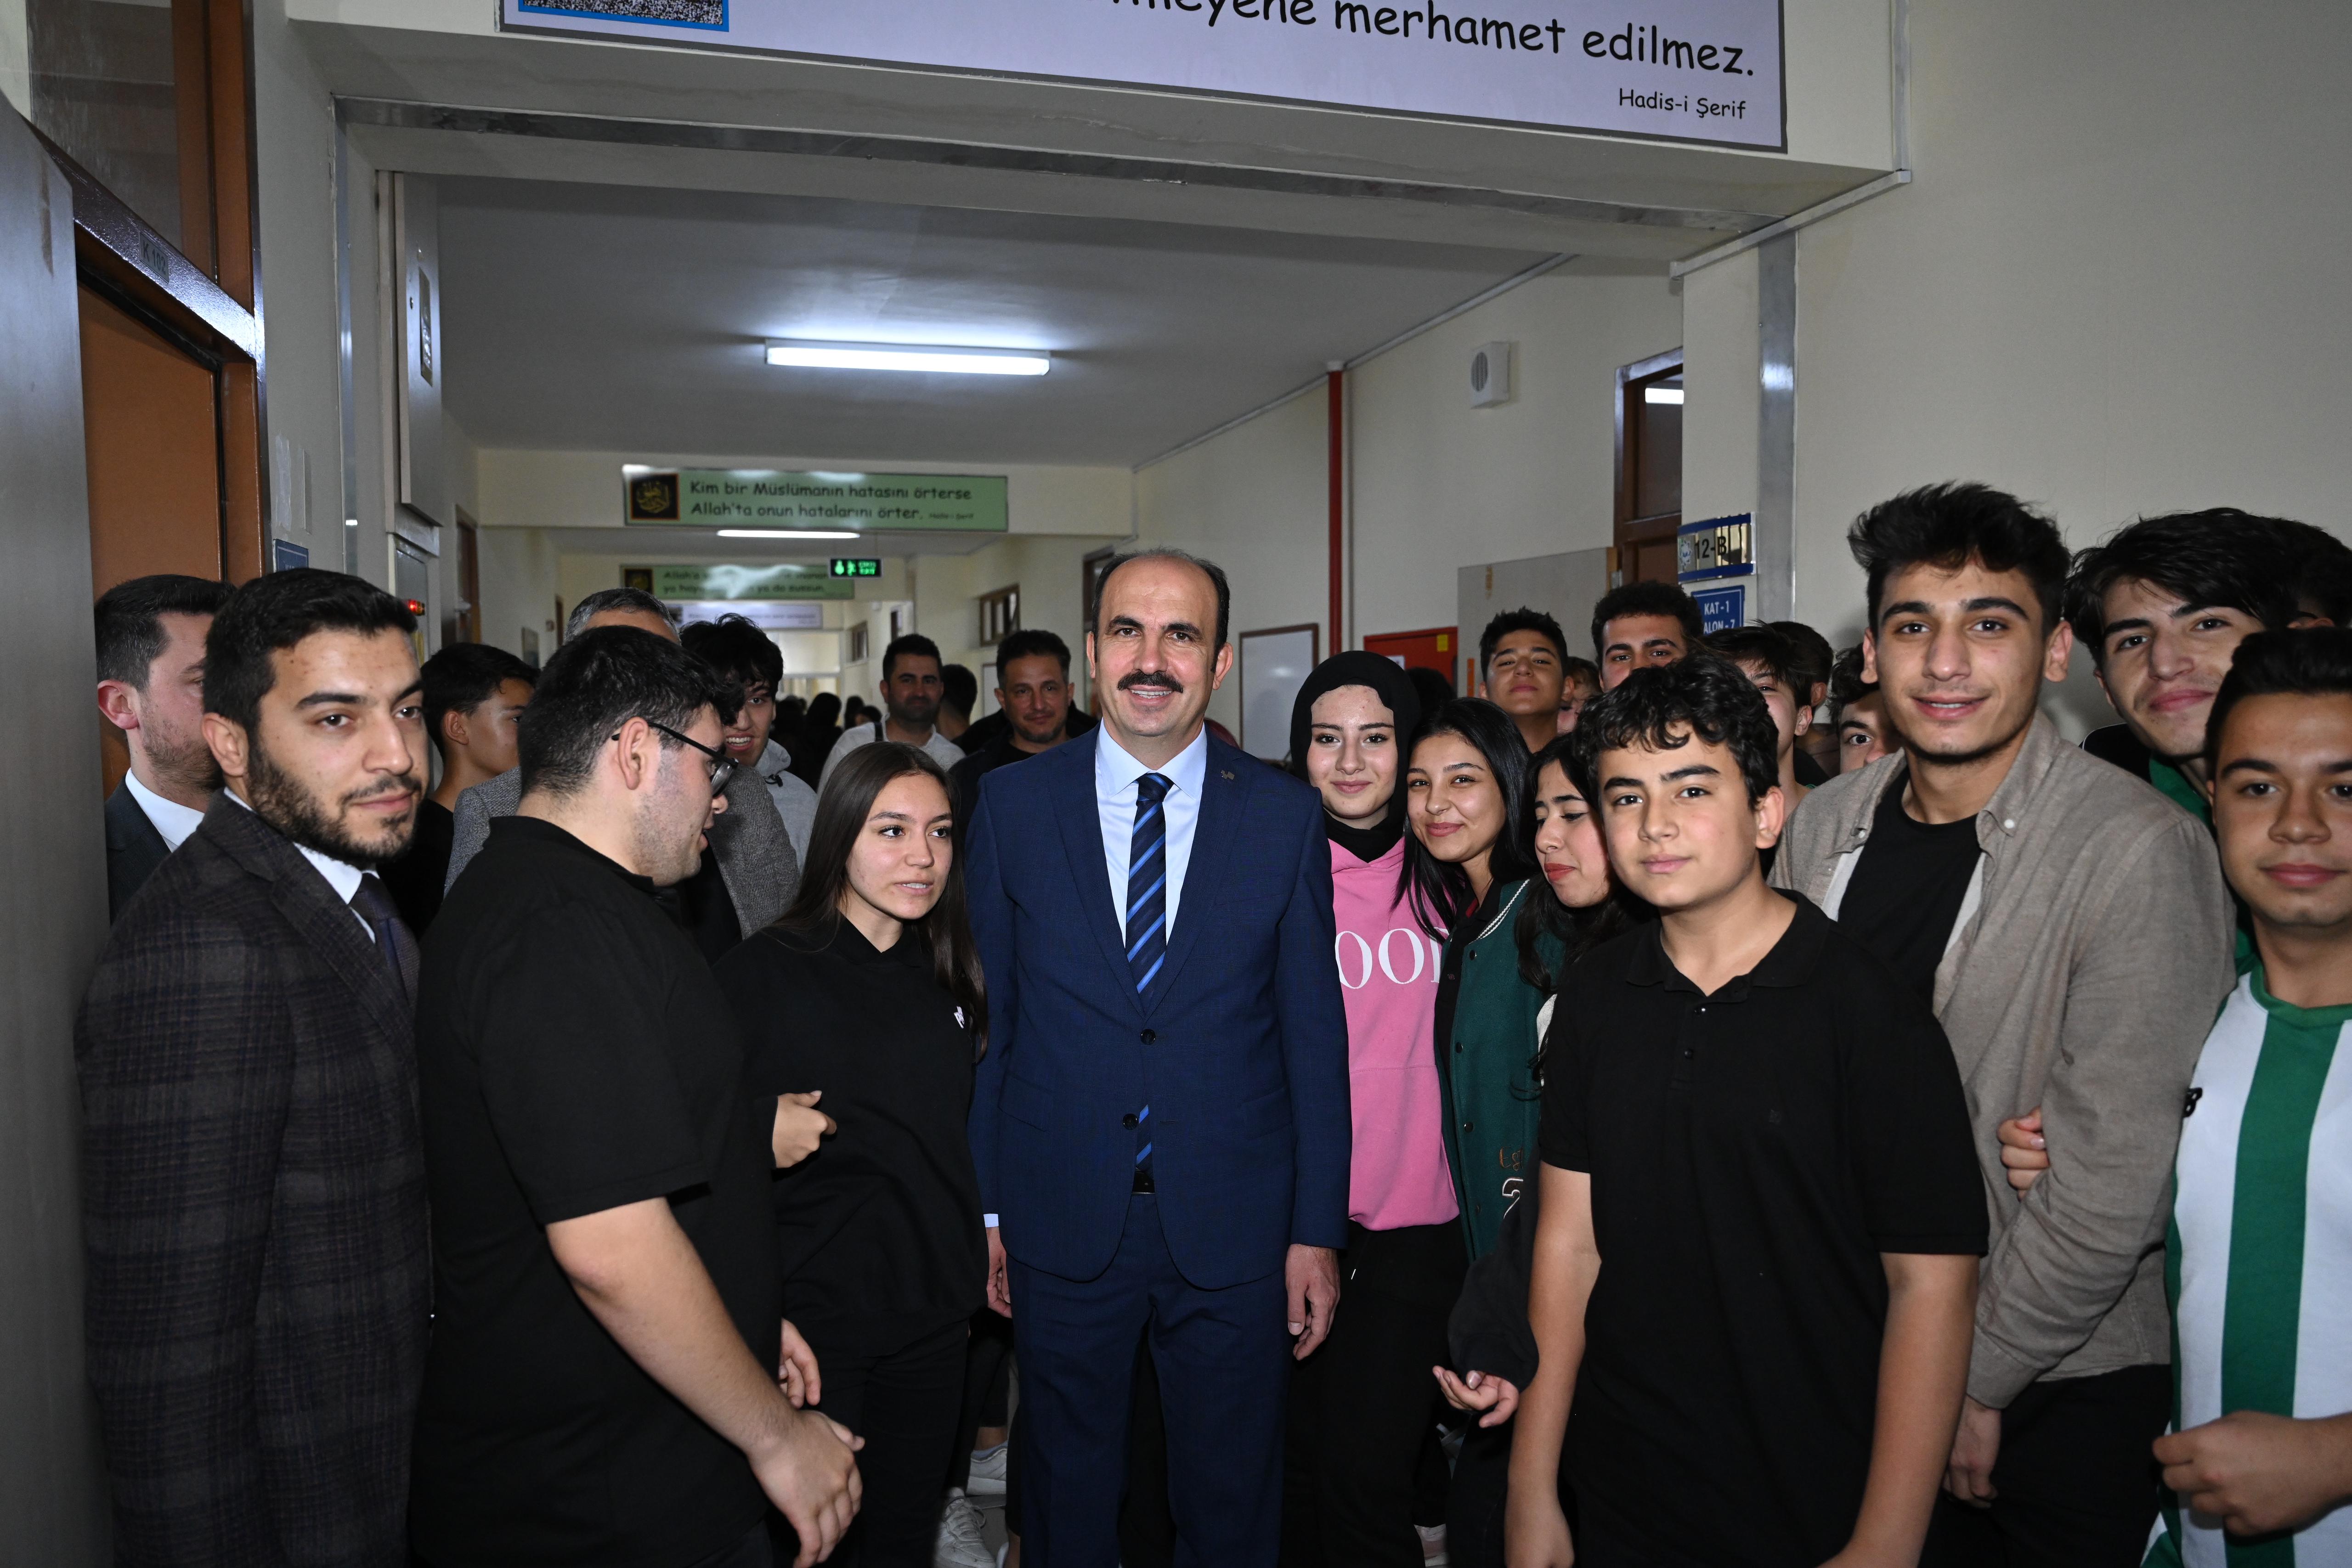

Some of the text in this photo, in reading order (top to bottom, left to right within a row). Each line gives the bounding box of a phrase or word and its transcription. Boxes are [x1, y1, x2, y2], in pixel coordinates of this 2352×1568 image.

[1335, 0, 1566, 54] merhamet
[1583, 23, 1753, 76] edilmez.
[1619, 88, 1746, 119] Hadis-i Şerif
[690, 481, 719, 494] Kim
[724, 481, 748, 495] bir
[849, 485, 908, 498] hatasını
[914, 486, 972, 500] örterse
[691, 502, 752, 516] Allah'ta
[757, 507, 793, 517] onun
[799, 504, 872, 518] hatalarını
[1695, 536, 1727, 559] 12-B
[1703, 620, 1724, 634] ALON
